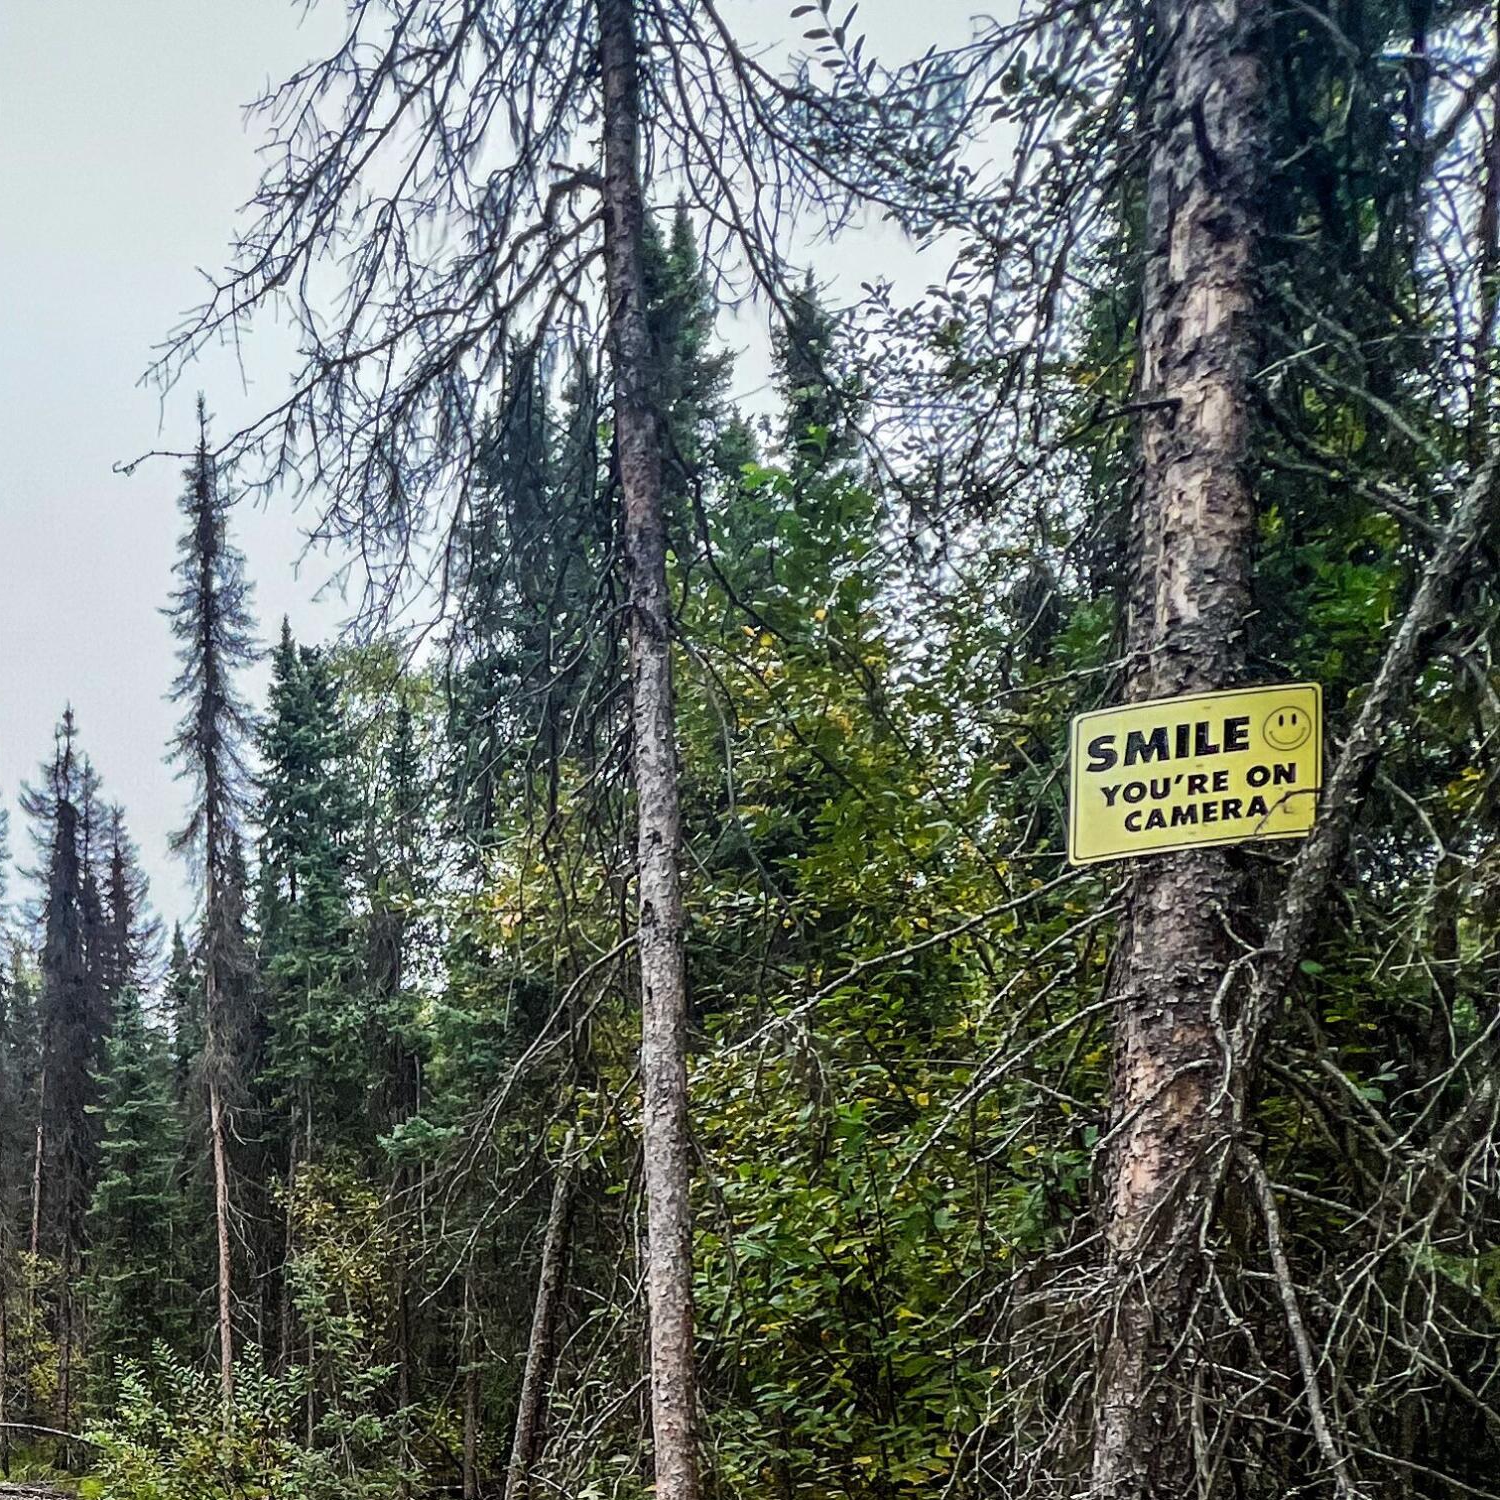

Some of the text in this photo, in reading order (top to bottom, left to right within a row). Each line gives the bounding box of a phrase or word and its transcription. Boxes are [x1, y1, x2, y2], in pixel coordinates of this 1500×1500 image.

[1085, 715, 1250, 773] SMILE
[1100, 761, 1297, 808] YOU'RE ON
[1123, 794, 1270, 833] CAMERA
